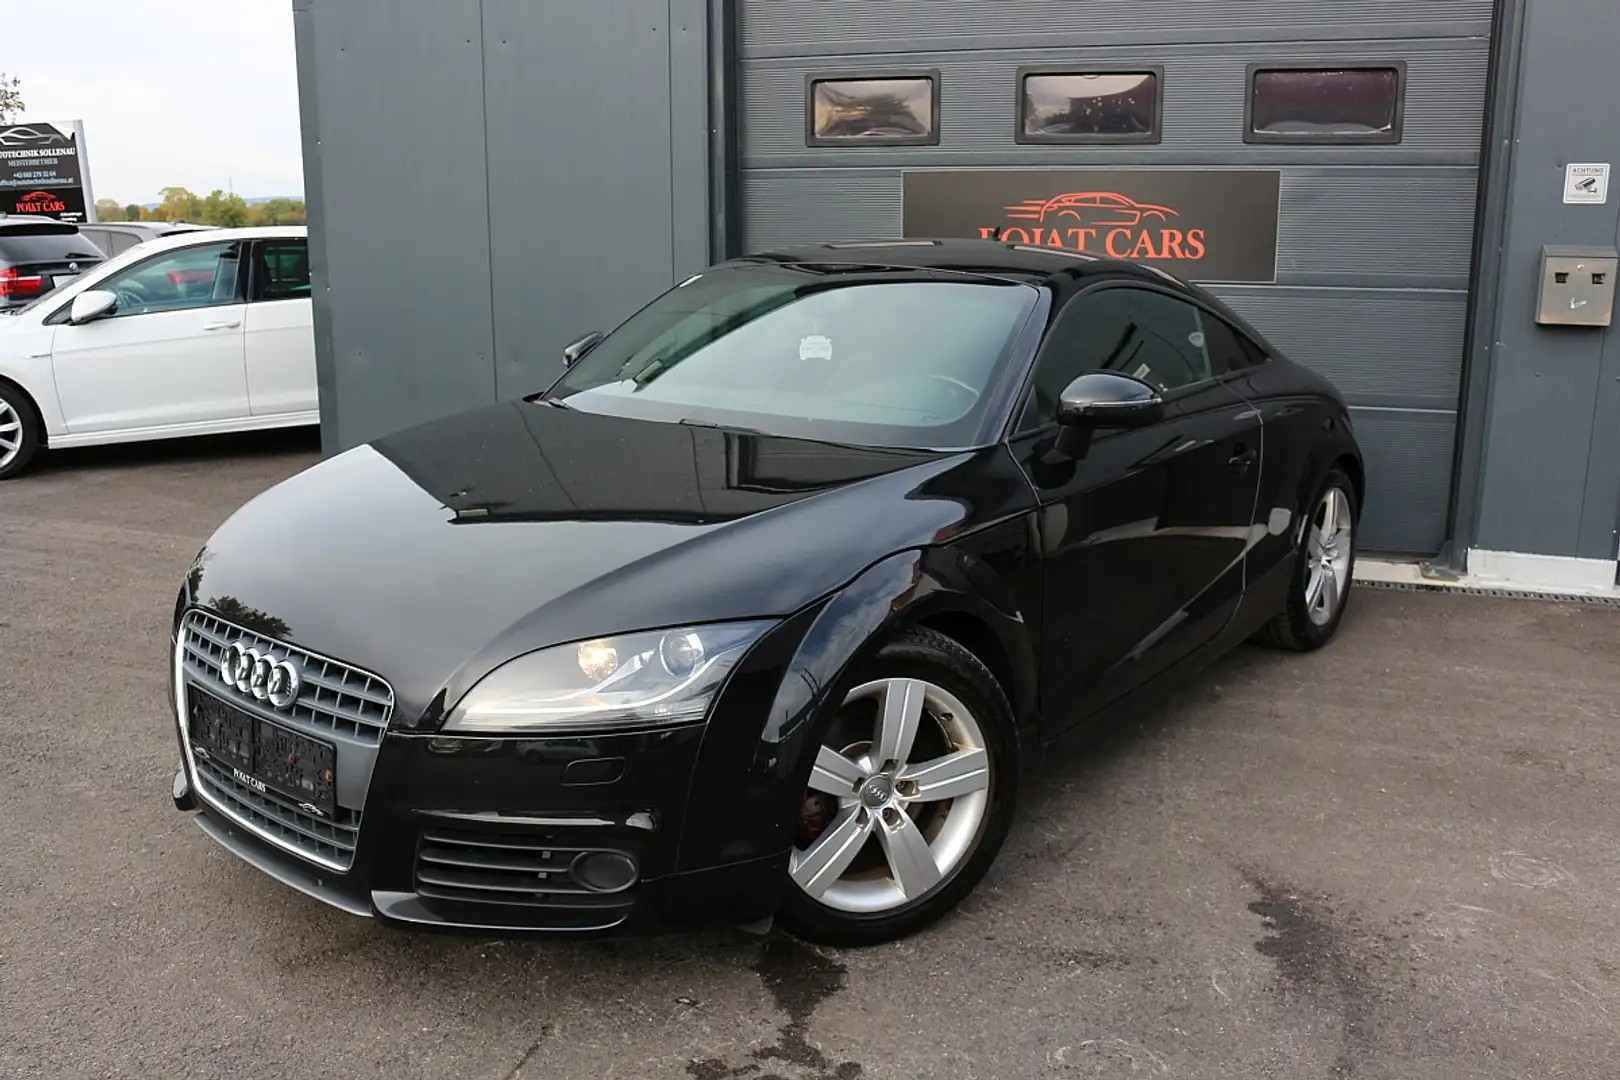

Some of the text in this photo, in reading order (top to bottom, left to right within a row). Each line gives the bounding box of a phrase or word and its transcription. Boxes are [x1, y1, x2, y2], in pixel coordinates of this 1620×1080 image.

[16, 201, 65, 213] POLAT CARS
[1105, 227, 1206, 260] CARS
